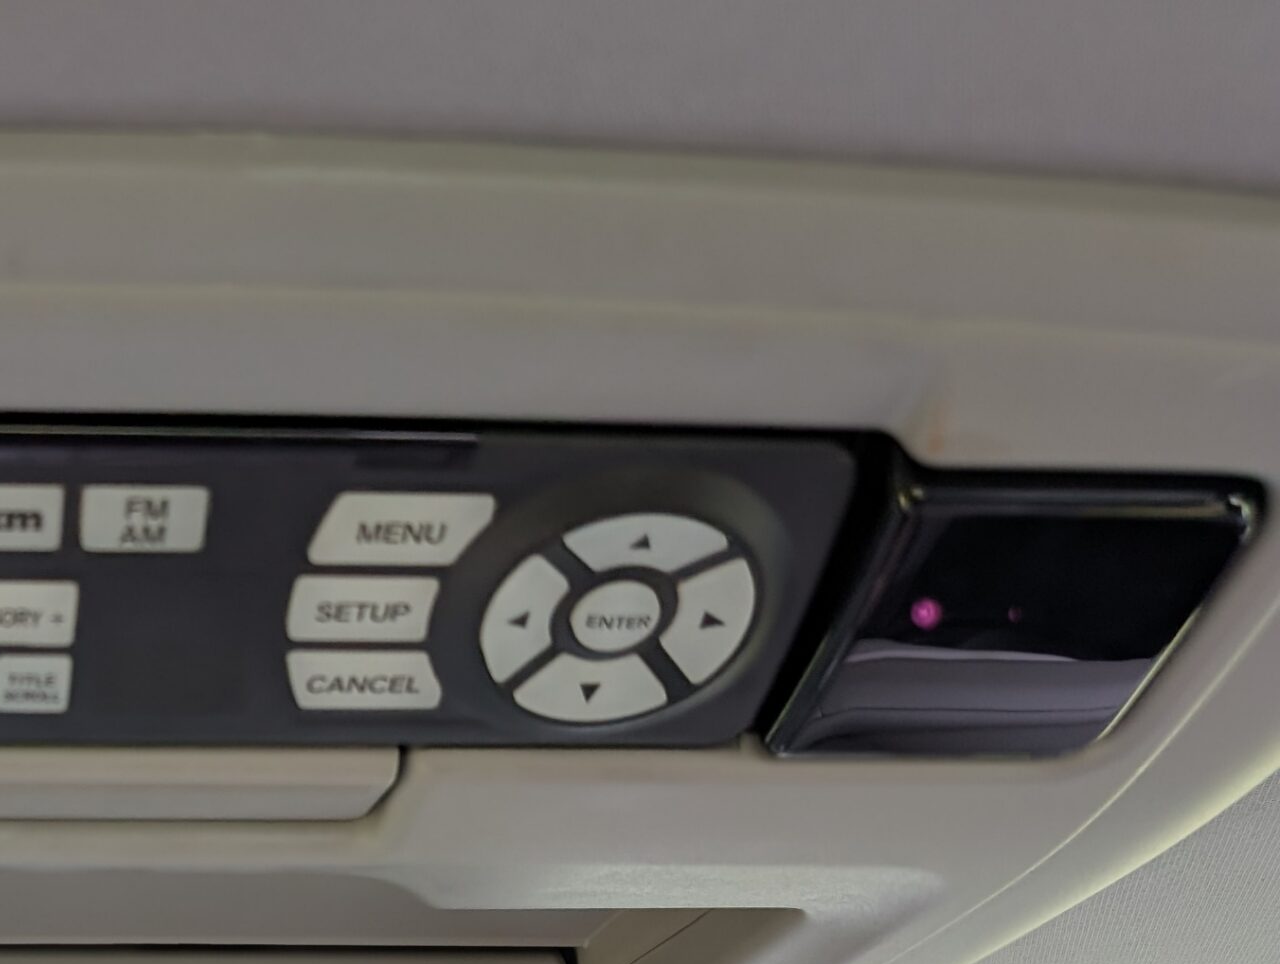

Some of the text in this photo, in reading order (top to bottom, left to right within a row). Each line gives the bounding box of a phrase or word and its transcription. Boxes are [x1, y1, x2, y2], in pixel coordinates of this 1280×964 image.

[124, 496, 169, 521] FM
[119, 524, 166, 545] AM
[355, 521, 447, 545] MENU
[314, 601, 412, 623] SETUP
[585, 613, 651, 631] ENTER
[305, 674, 420, 695] CANCEL
